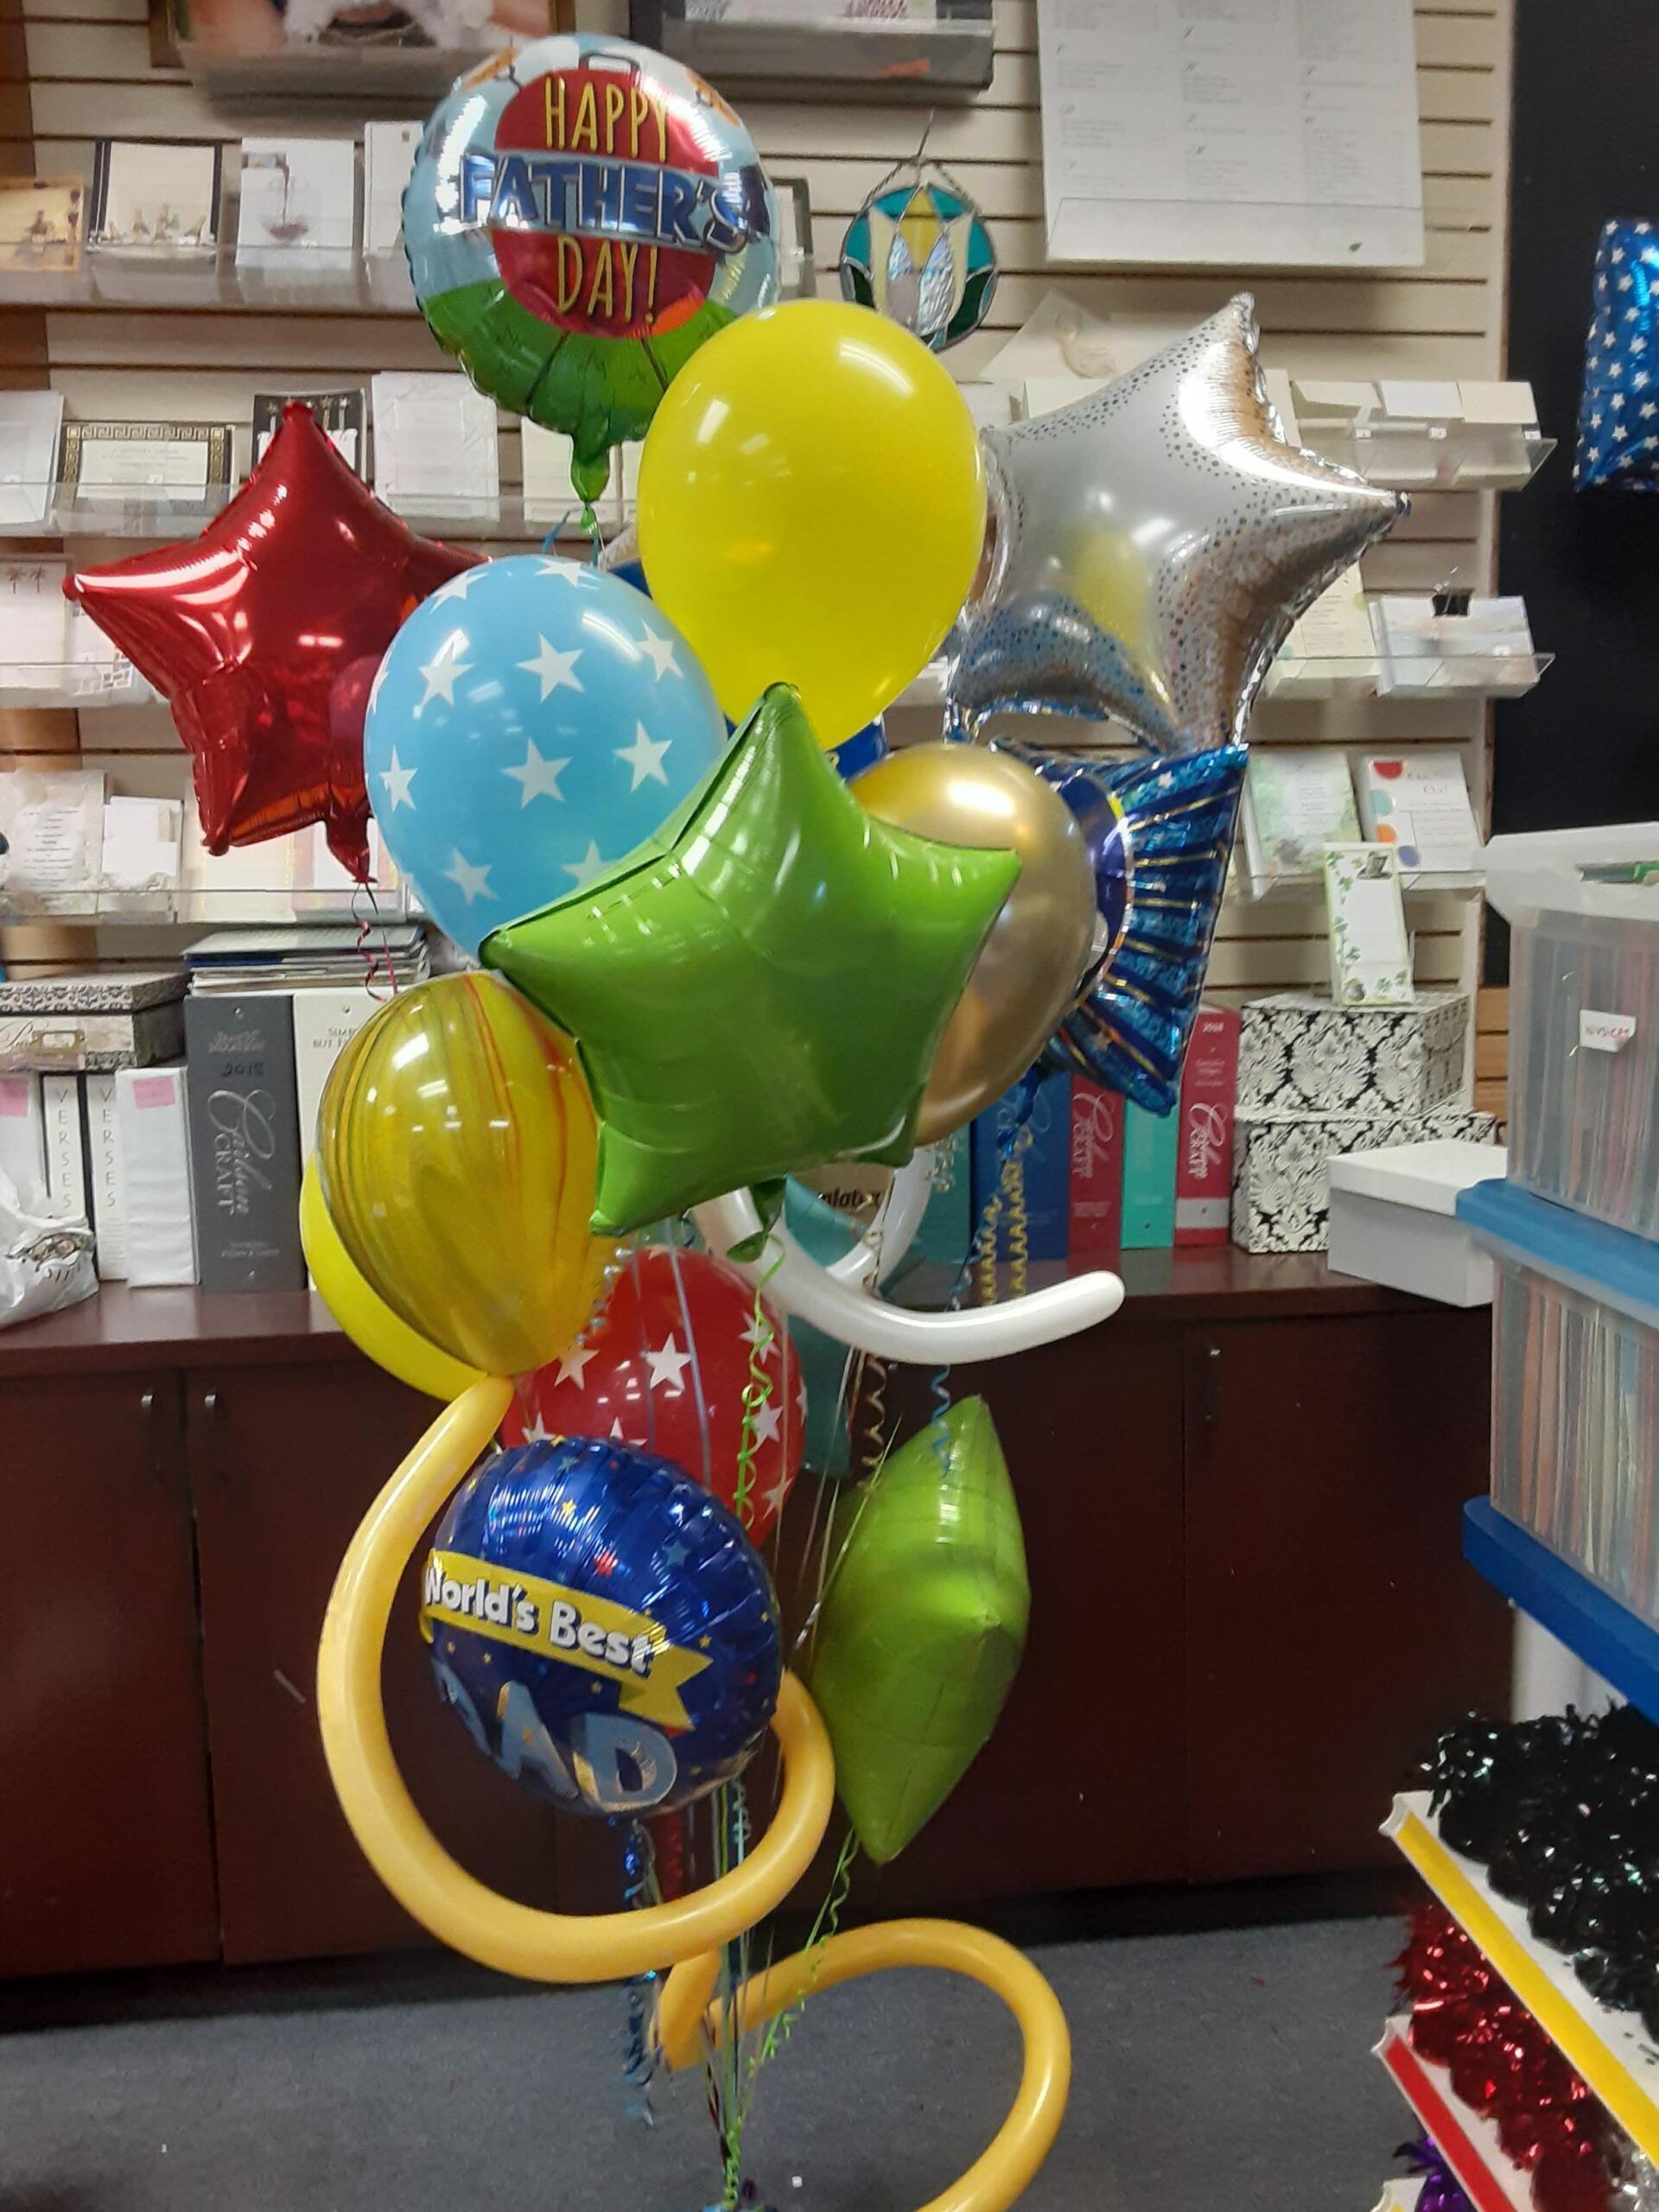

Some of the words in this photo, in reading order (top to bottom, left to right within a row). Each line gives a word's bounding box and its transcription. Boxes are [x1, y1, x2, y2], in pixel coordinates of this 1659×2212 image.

[545, 76, 670, 162] HAPPY
[459, 152, 749, 254] FATHER'S
[557, 234, 659, 325] DAY!
[55, 1086, 72, 1209] VERSES
[100, 1086, 116, 1208] VERSES
[550, 1600, 655, 1678] Best
